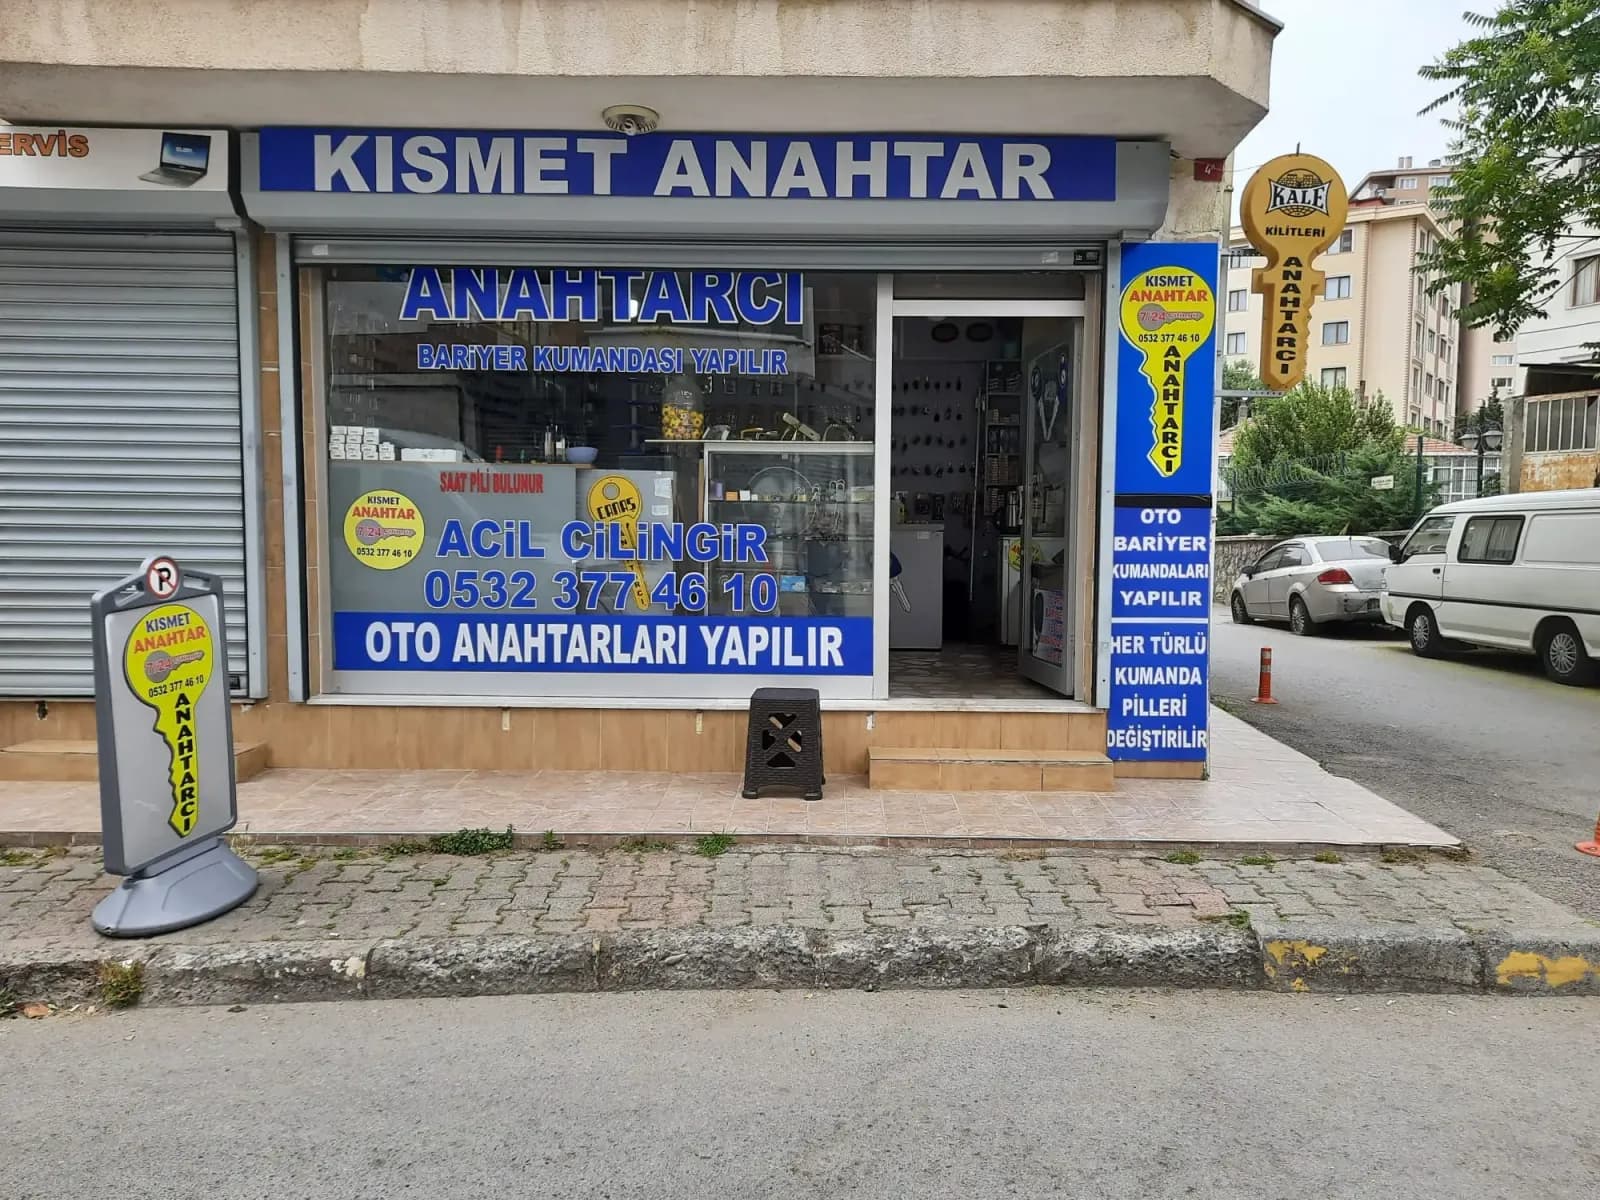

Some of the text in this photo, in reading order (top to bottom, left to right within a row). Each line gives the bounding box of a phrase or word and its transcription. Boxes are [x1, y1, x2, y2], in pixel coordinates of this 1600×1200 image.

[314, 134, 1055, 200] KISMET ANAHTAR
[1271, 185, 1326, 209] KALE
[1265, 224, 1326, 238] KİLİTLERİ
[1145, 275, 1195, 287] KISMET
[399, 268, 804, 325] ANAHTARCI
[1129, 289, 1208, 302] ANAHTAR
[1275, 256, 1303, 374] ANAHTARCI
[1138, 333, 1200, 343] 0532 377 46 10
[533, 346, 683, 374] KUMANDASI
[693, 348, 788, 375] YAPILIR
[1161, 345, 1181, 472] ANAHTARCI
[440, 472, 467, 493] SAAT
[493, 473, 544, 494] BULUNUR
[367, 496, 401, 505] KISMET
[351, 506, 416, 520] ANAHTAR
[1140, 508, 1182, 524] OTO
[356, 547, 413, 558] 0532 377 46 10
[1113, 532, 1208, 552] BARİYER
[1112, 563, 1209, 579] KUMANDALARI
[423, 569, 779, 613] 0532 377 46 10
[1119, 590, 1203, 607] YAPILIR
[145, 613, 191, 633] KISMET
[133, 626, 206, 654] ANAHTAR
[364, 621, 845, 666] OTO ANAHTARLARI YAPILIR
[1110, 631, 1207, 655] HER TÜRLÜ
[148, 674, 205, 698] 0532 377 46 10
[1115, 666, 1202, 686] KUMANDA
[1122, 693, 1187, 717] PİLLERİ
[1106, 724, 1208, 751] DEĞİŞTİRİLİR
[174, 693, 195, 832] ANAHTARCI
